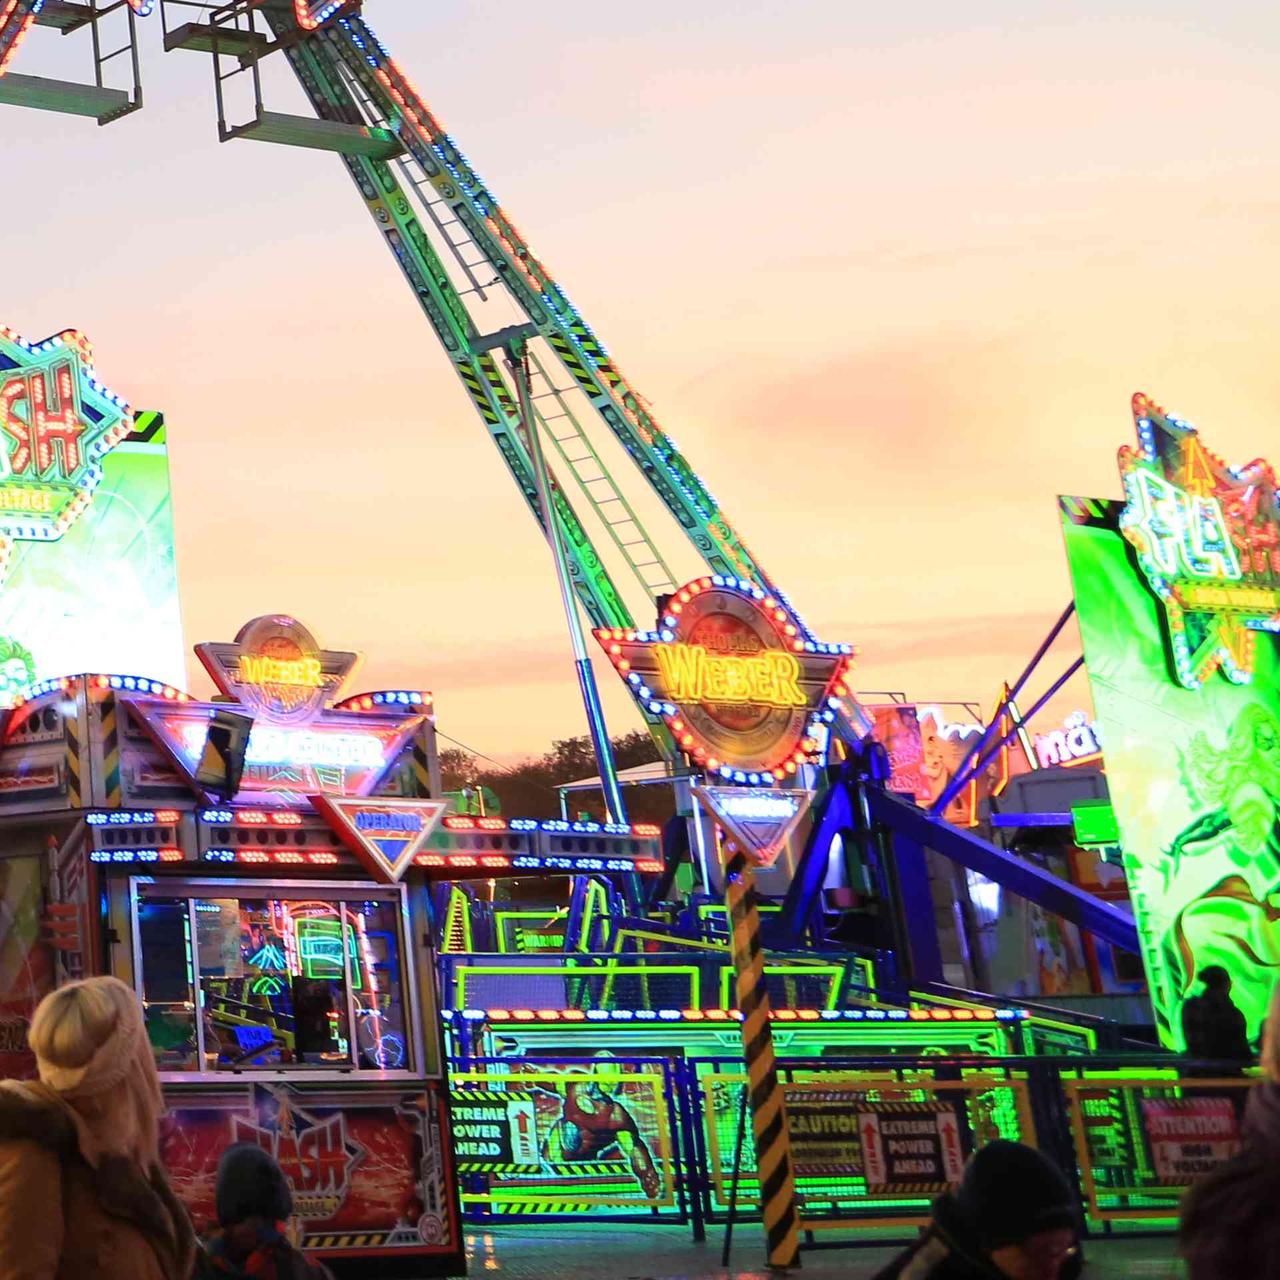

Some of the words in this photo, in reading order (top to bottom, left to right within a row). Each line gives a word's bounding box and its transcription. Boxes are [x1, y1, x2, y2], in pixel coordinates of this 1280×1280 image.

[240, 655, 324, 686] WEBER
[652, 642, 807, 708] WEBER
[452, 1124, 502, 1139] OWER
[880, 1121, 937, 1135] EXTREME
[454, 1141, 502, 1156] HEAD
[889, 1139, 934, 1155] POWER
